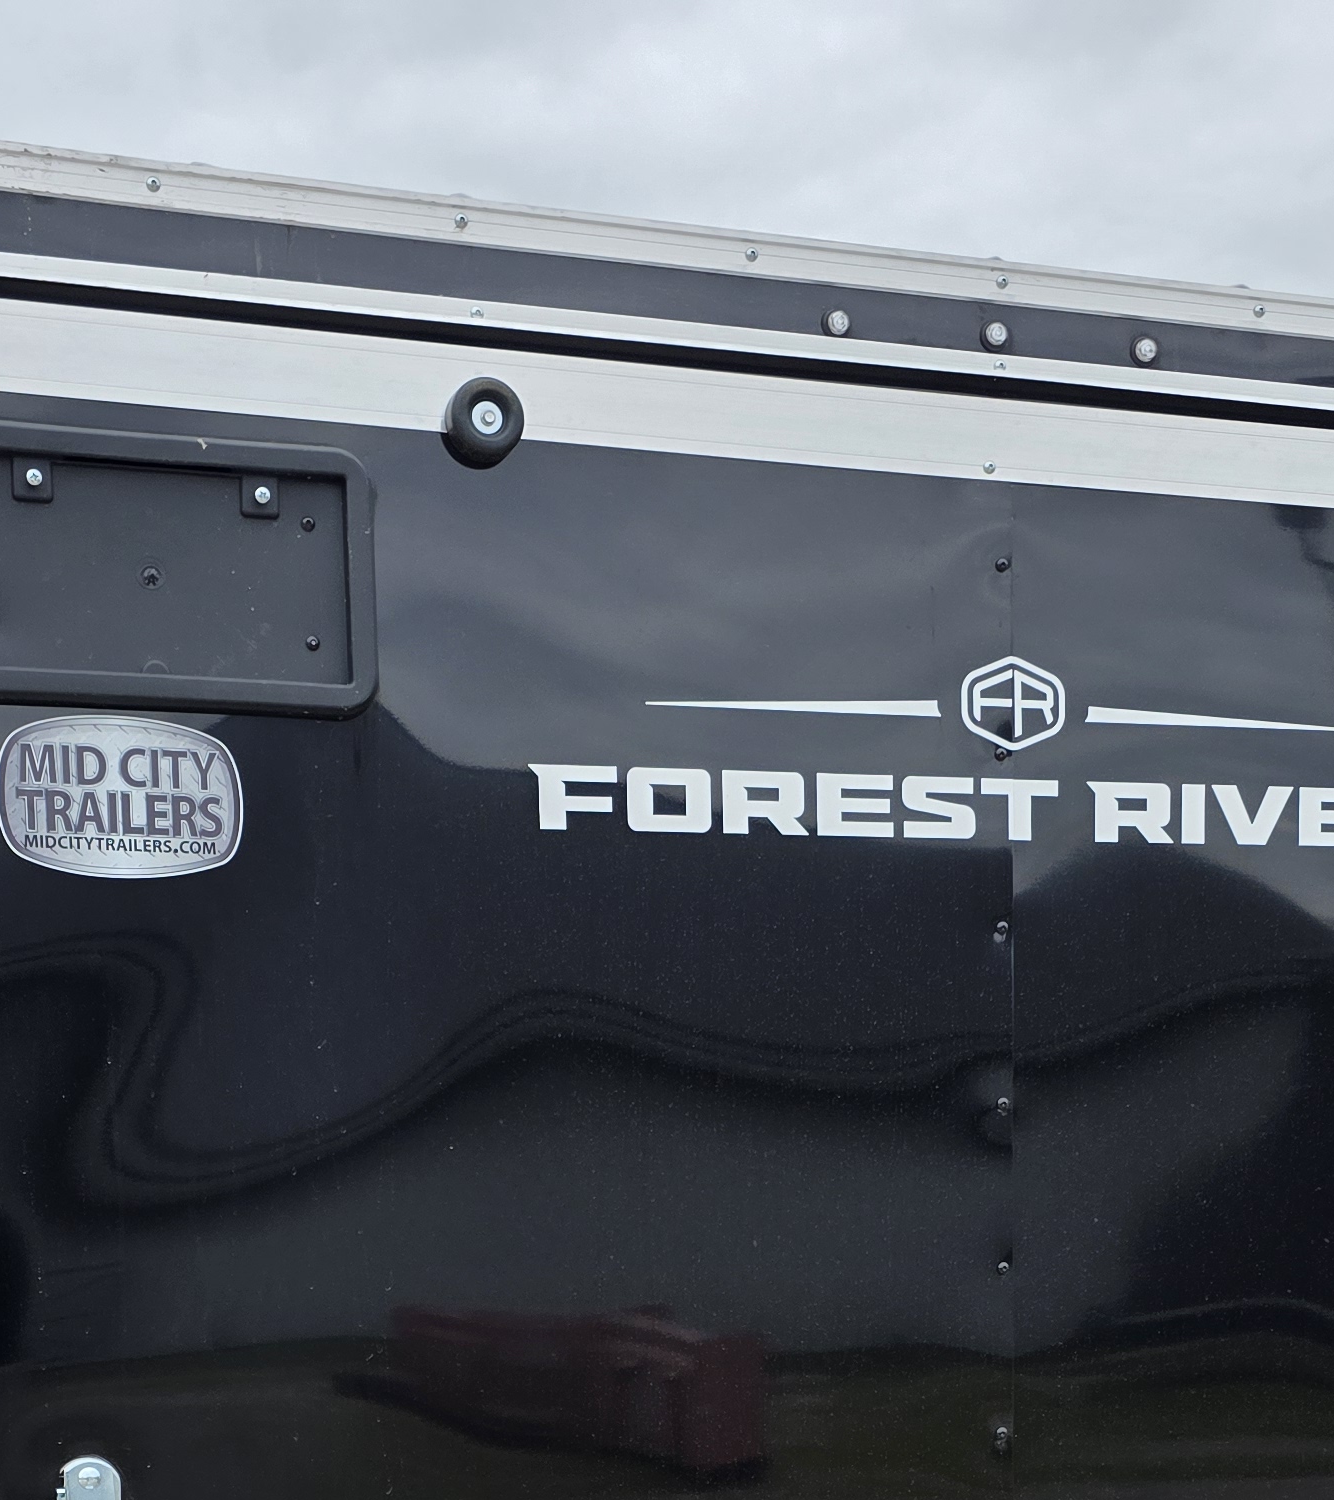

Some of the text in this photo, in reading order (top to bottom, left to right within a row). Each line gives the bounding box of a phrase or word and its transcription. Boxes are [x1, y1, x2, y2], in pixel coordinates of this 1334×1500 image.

[19, 743, 218, 791] MID CITY
[18, 788, 224, 839] TRAILERS
[528, 762, 1059, 842] FOREST
[24, 834, 217, 855] MIDCITYTRAILERS.COM
